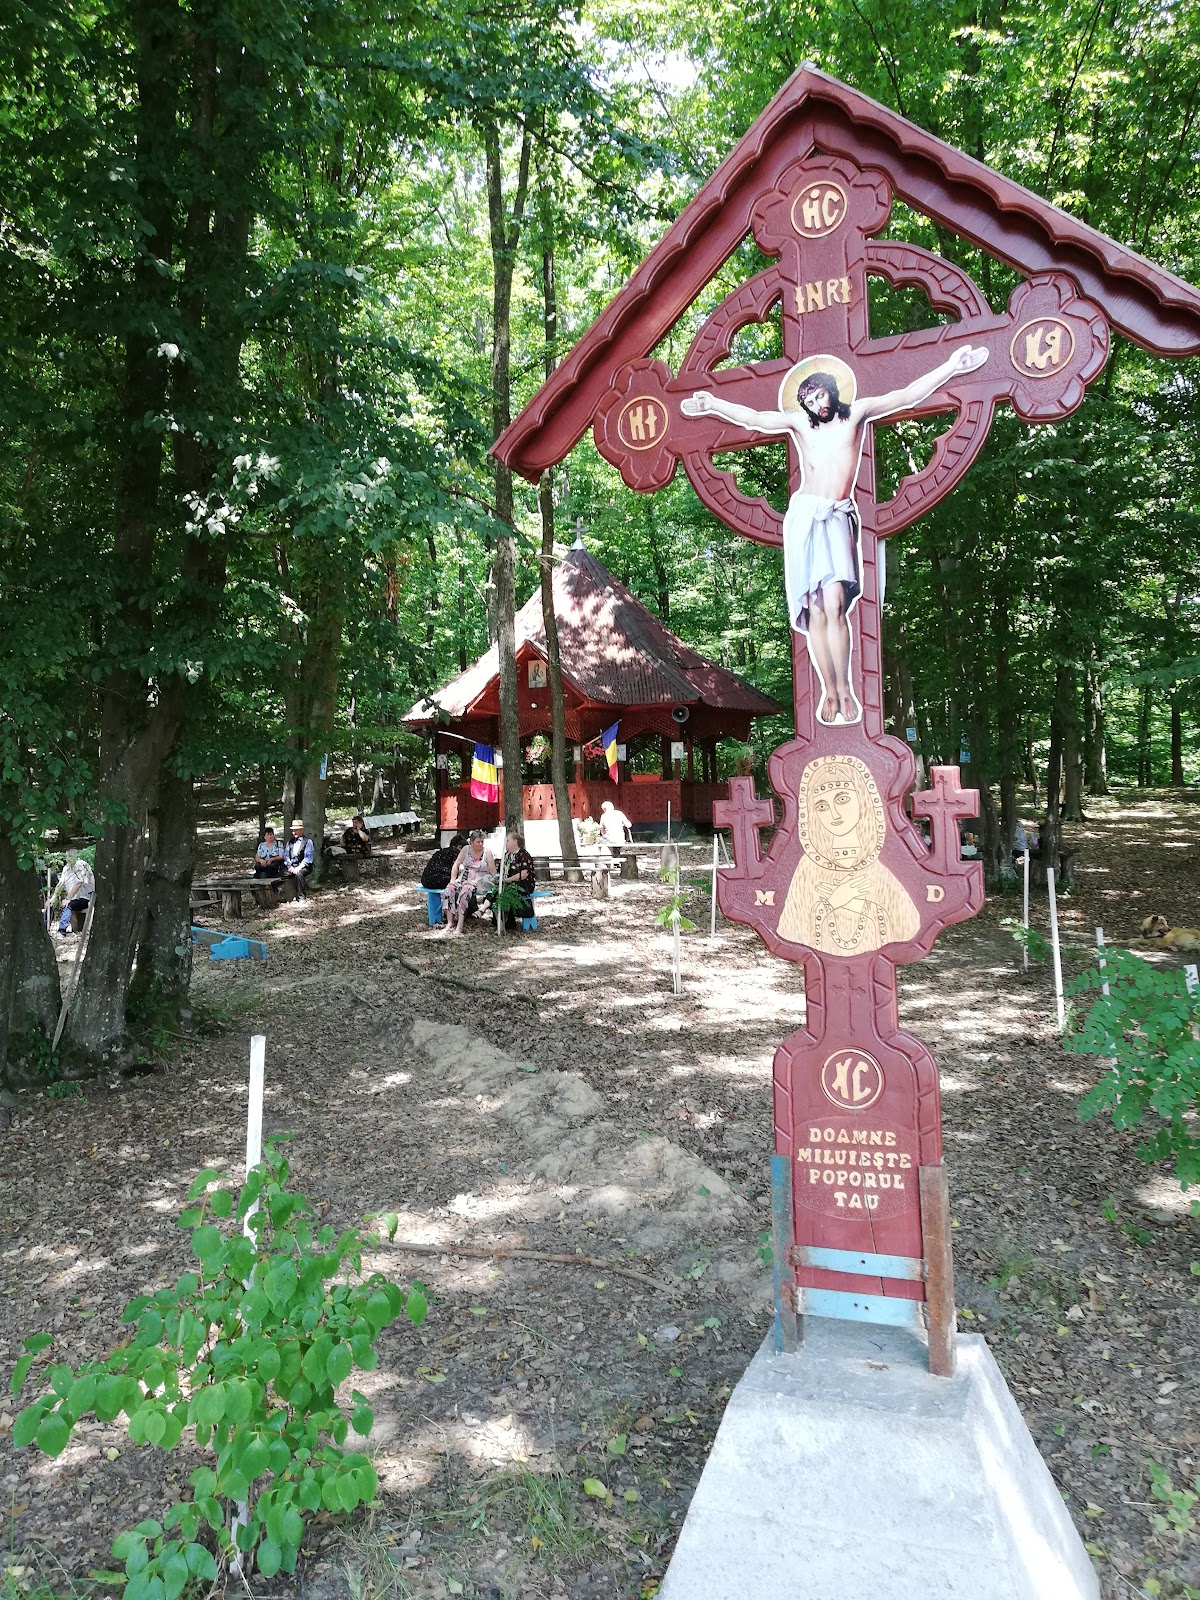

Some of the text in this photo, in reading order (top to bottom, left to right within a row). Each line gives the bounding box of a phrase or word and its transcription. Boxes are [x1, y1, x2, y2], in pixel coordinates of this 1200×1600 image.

[795, 276, 850, 314] INRI
[754, 890, 775, 906] M
[926, 884, 945, 903] D
[809, 1127, 897, 1146] DOAMNE
[809, 1168, 905, 1189] POPORUL
[833, 1191, 880, 1210] TAU
